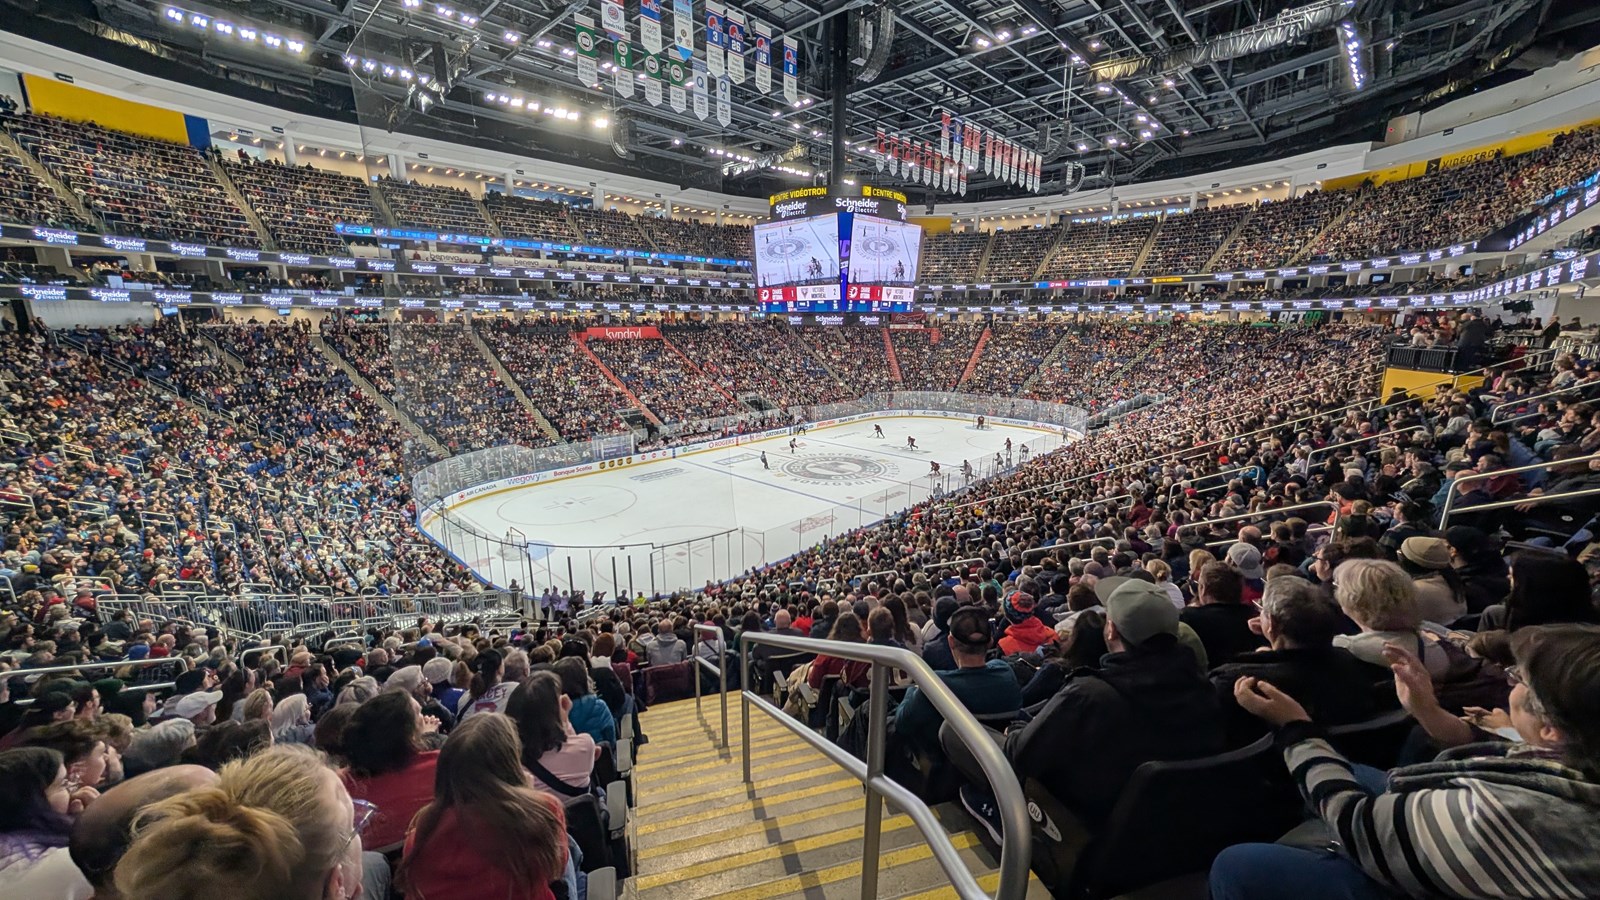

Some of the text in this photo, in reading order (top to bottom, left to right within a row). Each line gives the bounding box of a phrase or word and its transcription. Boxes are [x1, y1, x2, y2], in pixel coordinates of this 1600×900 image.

[712, 31, 719, 42] 3
[620, 56, 626, 67] 9
[696, 76, 705, 90] Q
[719, 80, 728, 94] Q
[790, 187, 827, 198] VIDÉOTRON
[873, 189, 892, 199] CENTRE
[775, 201, 807, 214] Schneider
[835, 198, 879, 208] Schneider
[35, 229, 77, 240] Schneider
[103, 237, 145, 247] Schneider
[170, 243, 206, 253] Schneider
[21, 287, 66, 296] Schneider
[90, 289, 130, 298] Schneider
[605, 328, 642, 339] kyndryl
[765, 429, 788, 437] GATORADE
[714, 438, 735, 448] ROGERS
[553, 465, 593, 478] Banque Scotia
[507, 473, 541, 486] wegovy
[474, 484, 497, 494] CANADA
